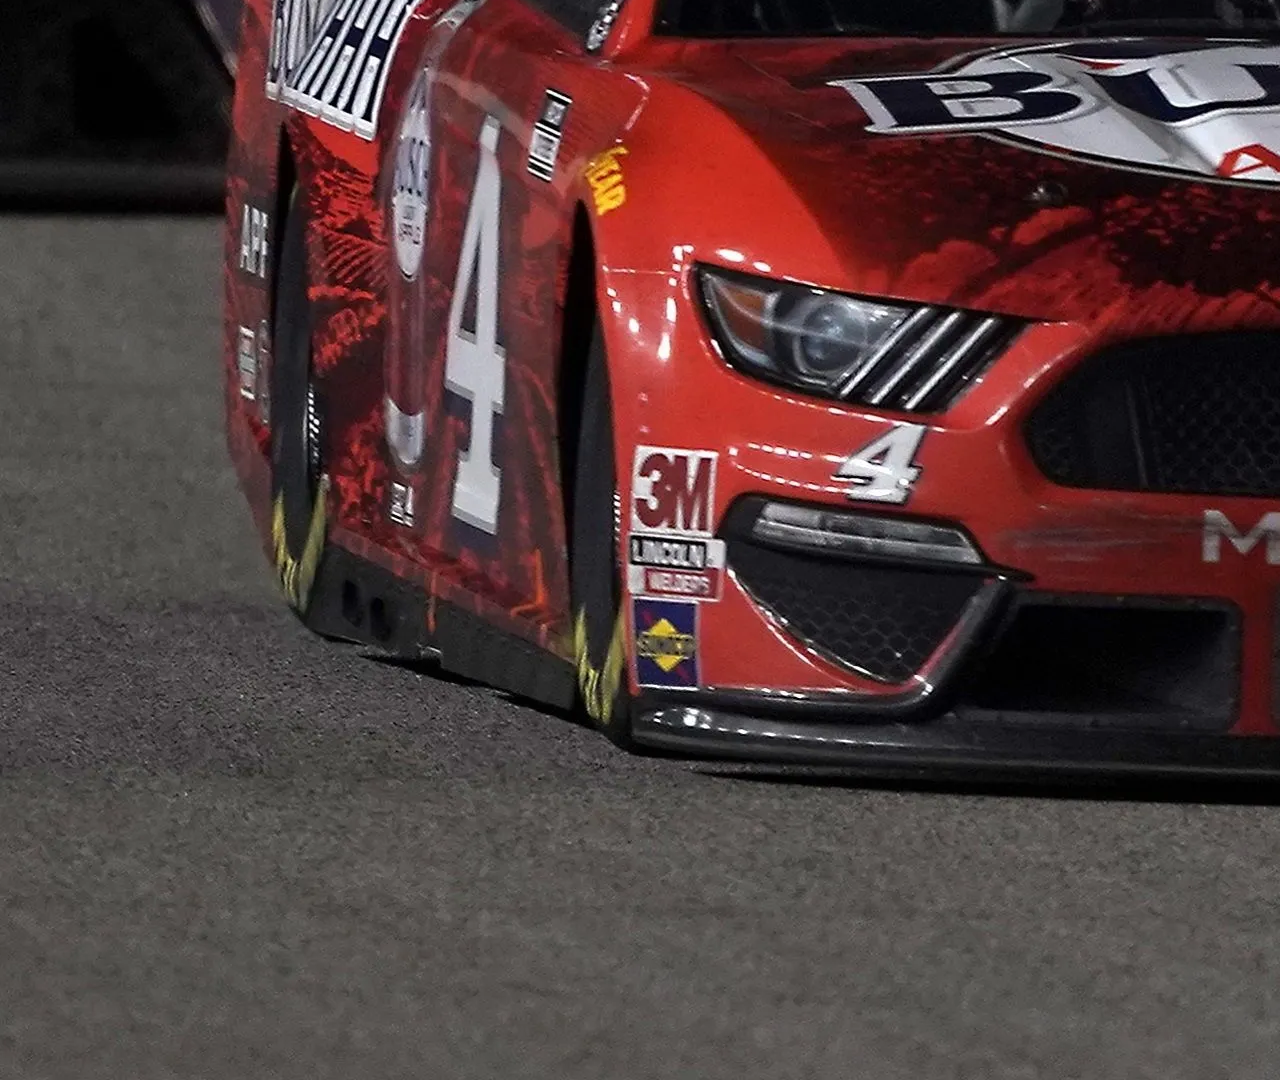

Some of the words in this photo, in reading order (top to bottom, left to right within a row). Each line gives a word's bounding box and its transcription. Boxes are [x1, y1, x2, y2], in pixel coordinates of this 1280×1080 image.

[445, 115, 507, 537] 4
[635, 452, 712, 531] 3M
[837, 423, 927, 504] 4
[630, 537, 705, 568] LINCOLN
